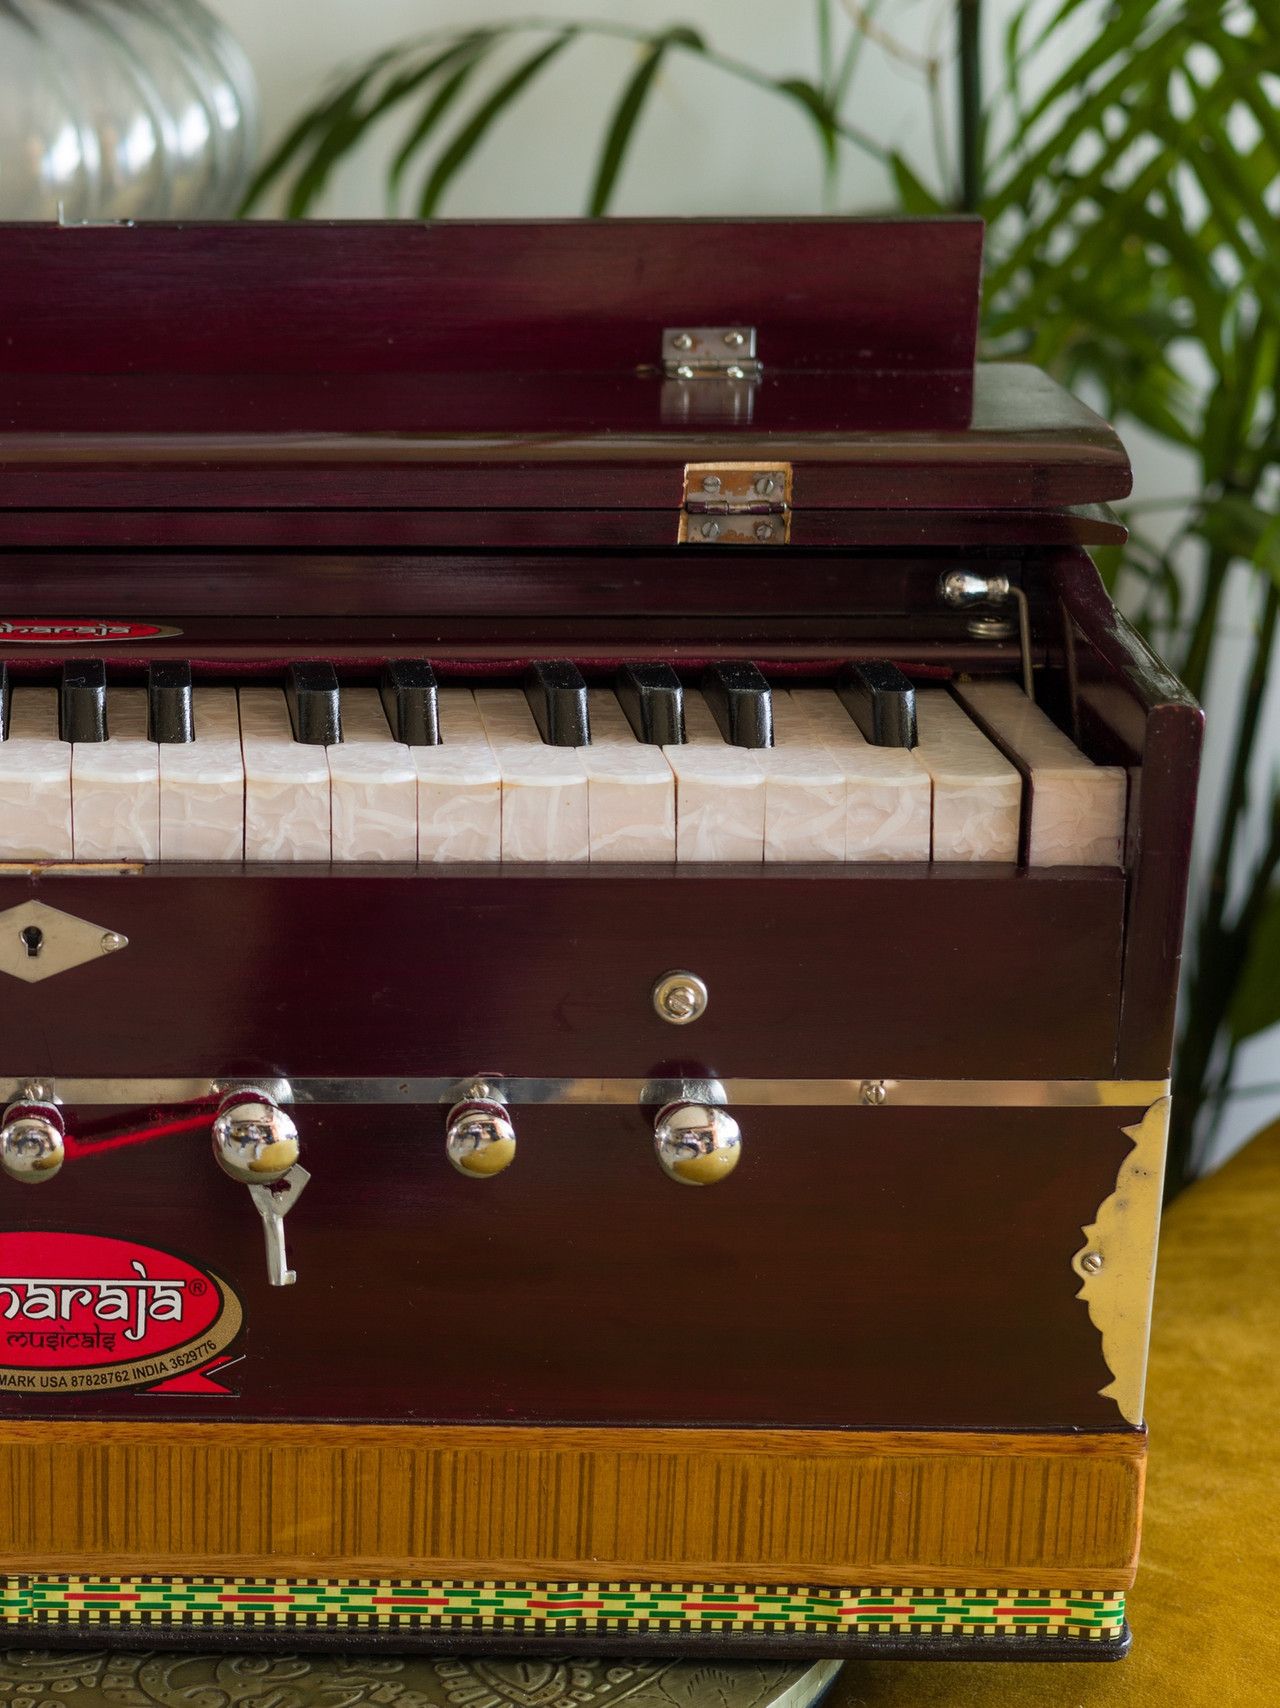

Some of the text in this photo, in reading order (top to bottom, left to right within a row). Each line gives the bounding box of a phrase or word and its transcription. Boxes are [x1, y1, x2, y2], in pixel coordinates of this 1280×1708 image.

[6, 1323, 116, 1352] musicals
[40, 1375, 68, 1388] USA
[70, 1369, 130, 1388] 87828762
[132, 1360, 169, 1380] INDIA
[170, 1339, 218, 1370] 3629776
